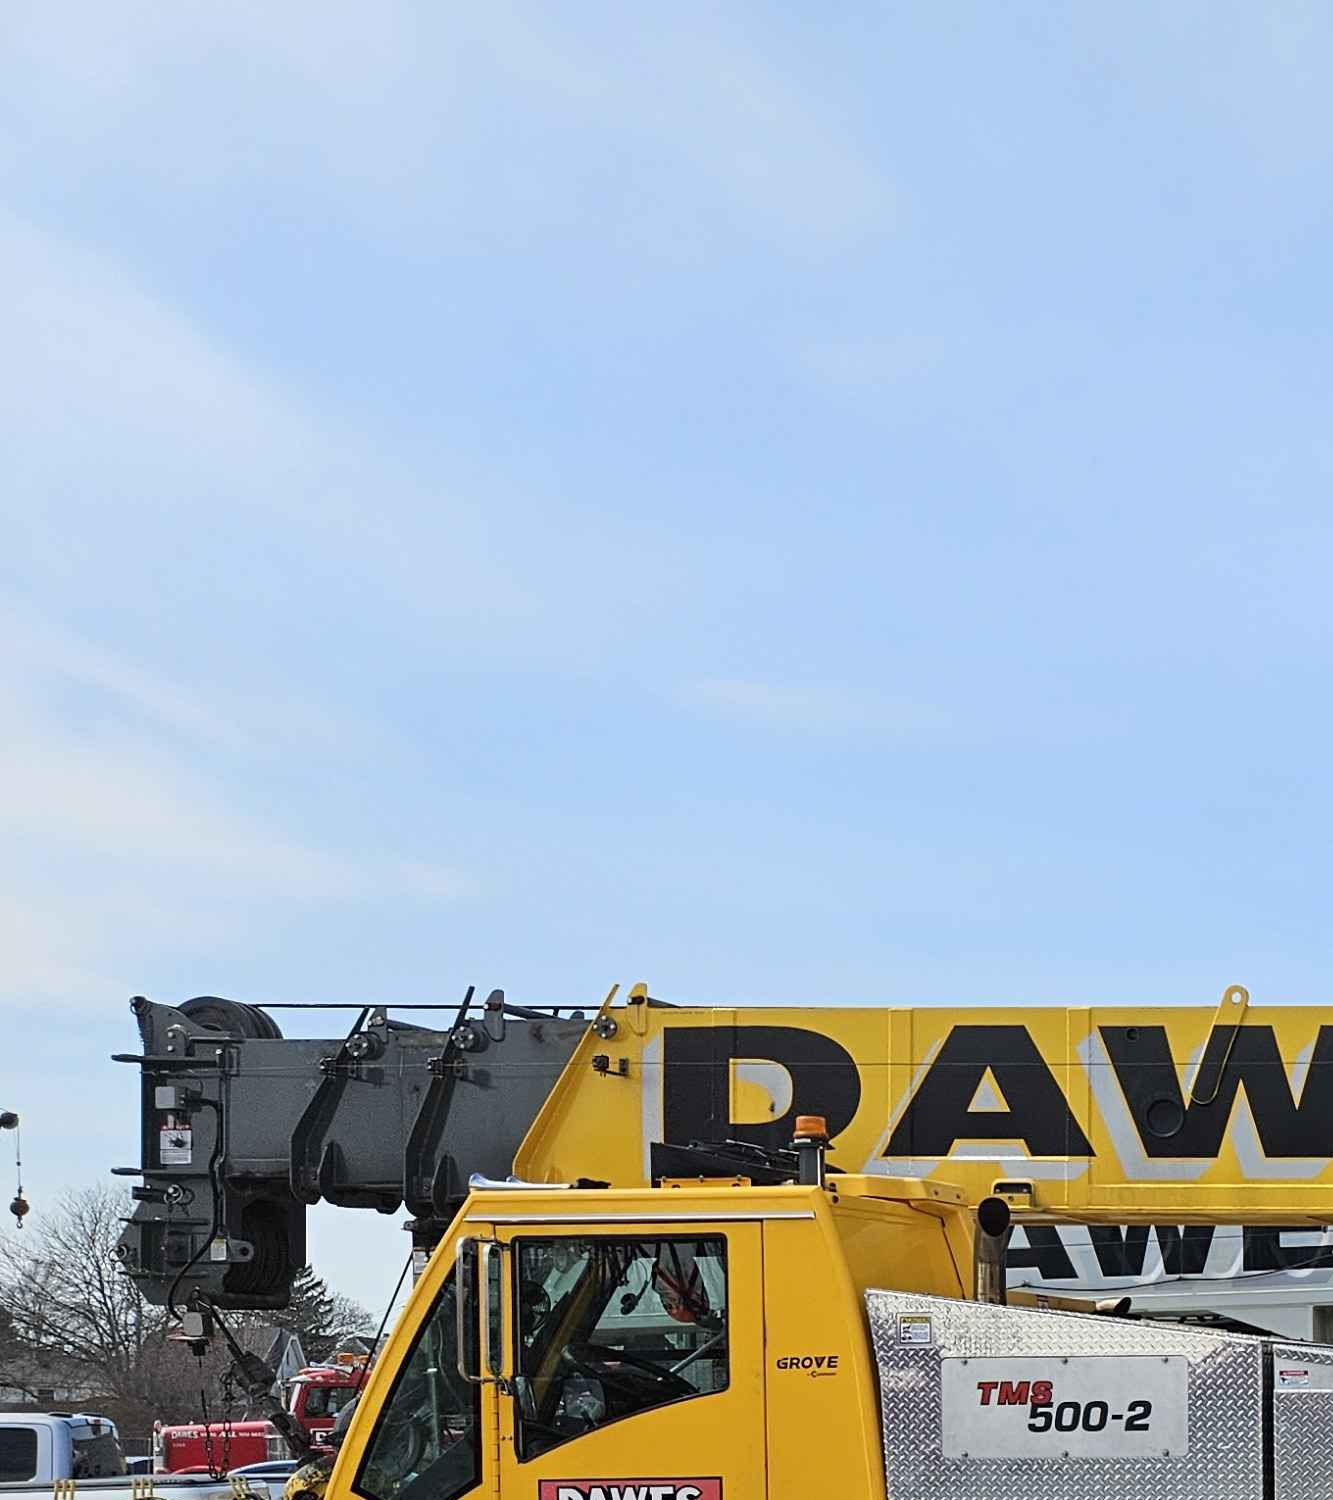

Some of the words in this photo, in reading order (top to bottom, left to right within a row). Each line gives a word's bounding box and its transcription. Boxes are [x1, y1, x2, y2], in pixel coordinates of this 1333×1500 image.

[776, 1356, 839, 1369] GROVE
[977, 1380, 1053, 1405] TMS
[1027, 1400, 1152, 1432] 500-2
